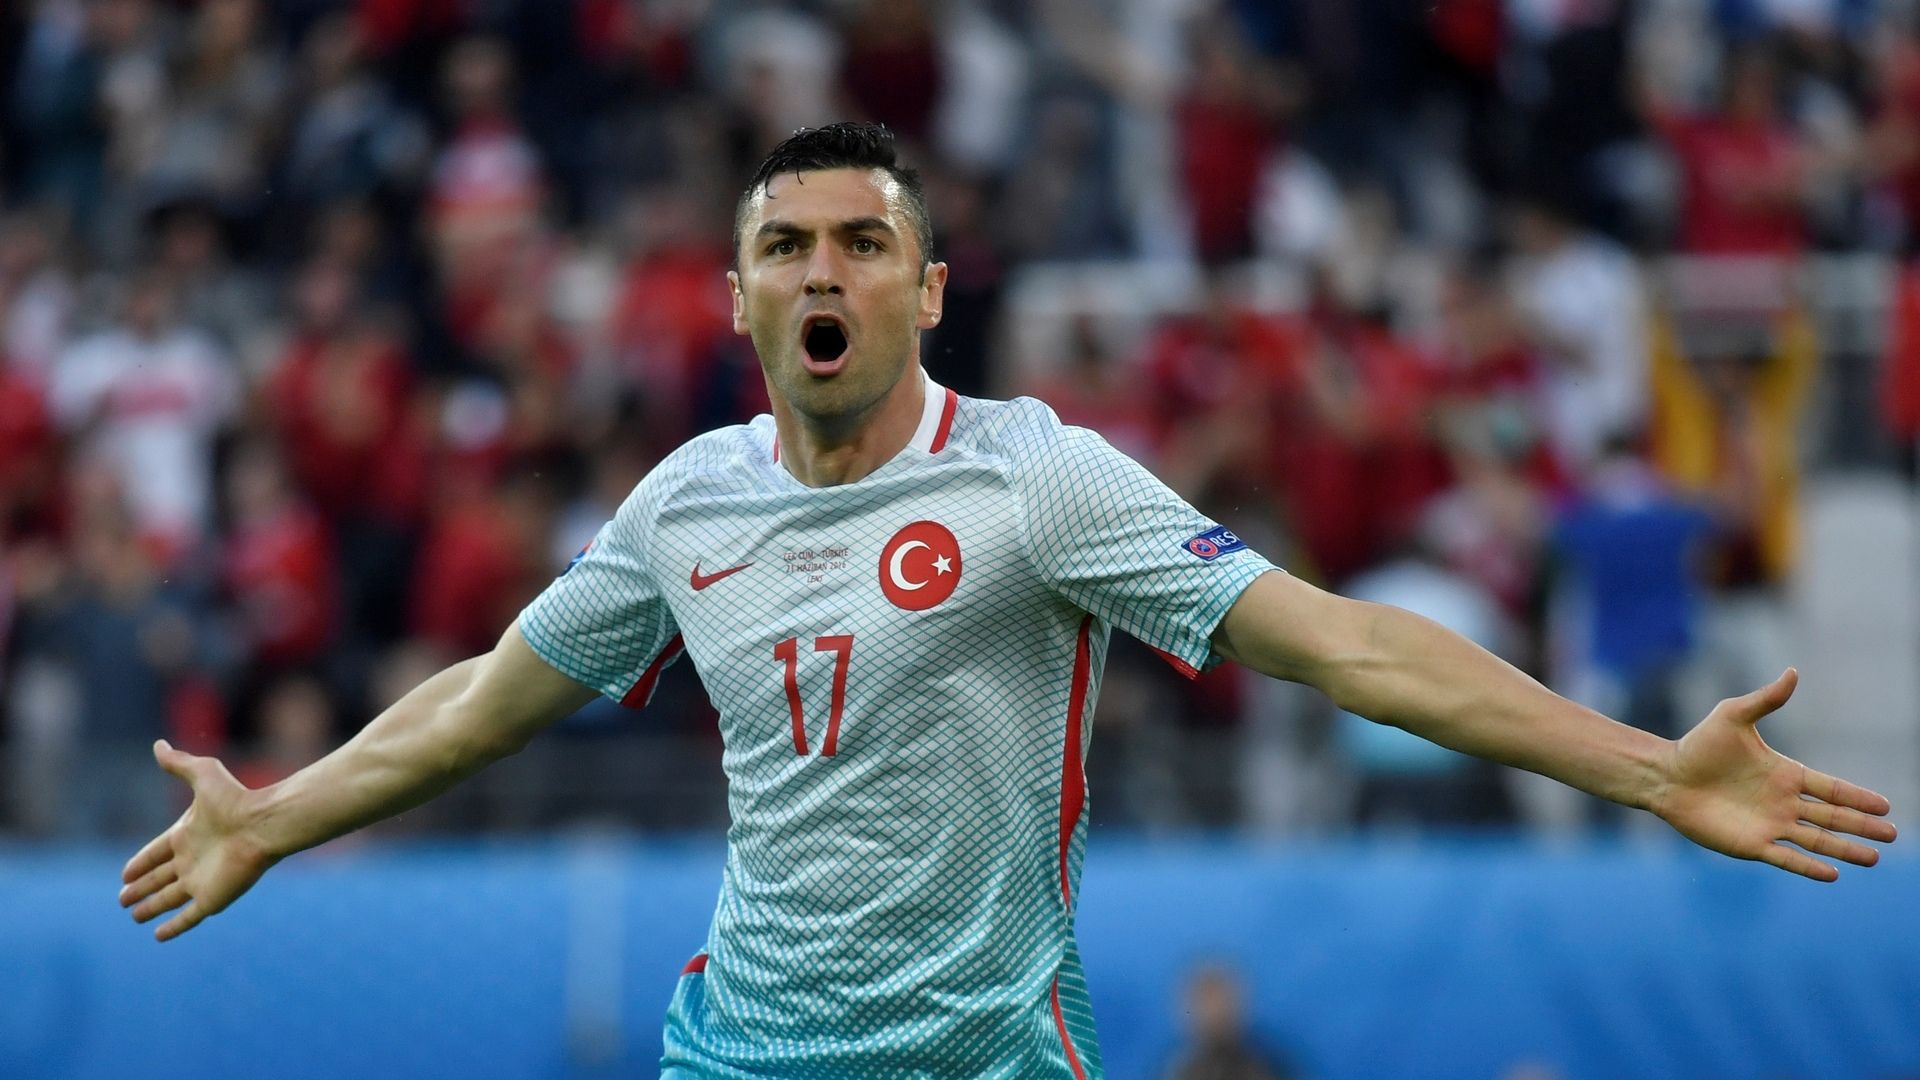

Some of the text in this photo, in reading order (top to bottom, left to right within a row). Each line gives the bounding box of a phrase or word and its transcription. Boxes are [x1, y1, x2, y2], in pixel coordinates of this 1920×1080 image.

[1209, 531, 1241, 547] RES
[829, 561, 846, 570] 2016
[807, 575, 823, 583] LENS
[774, 634, 855, 757] 17
